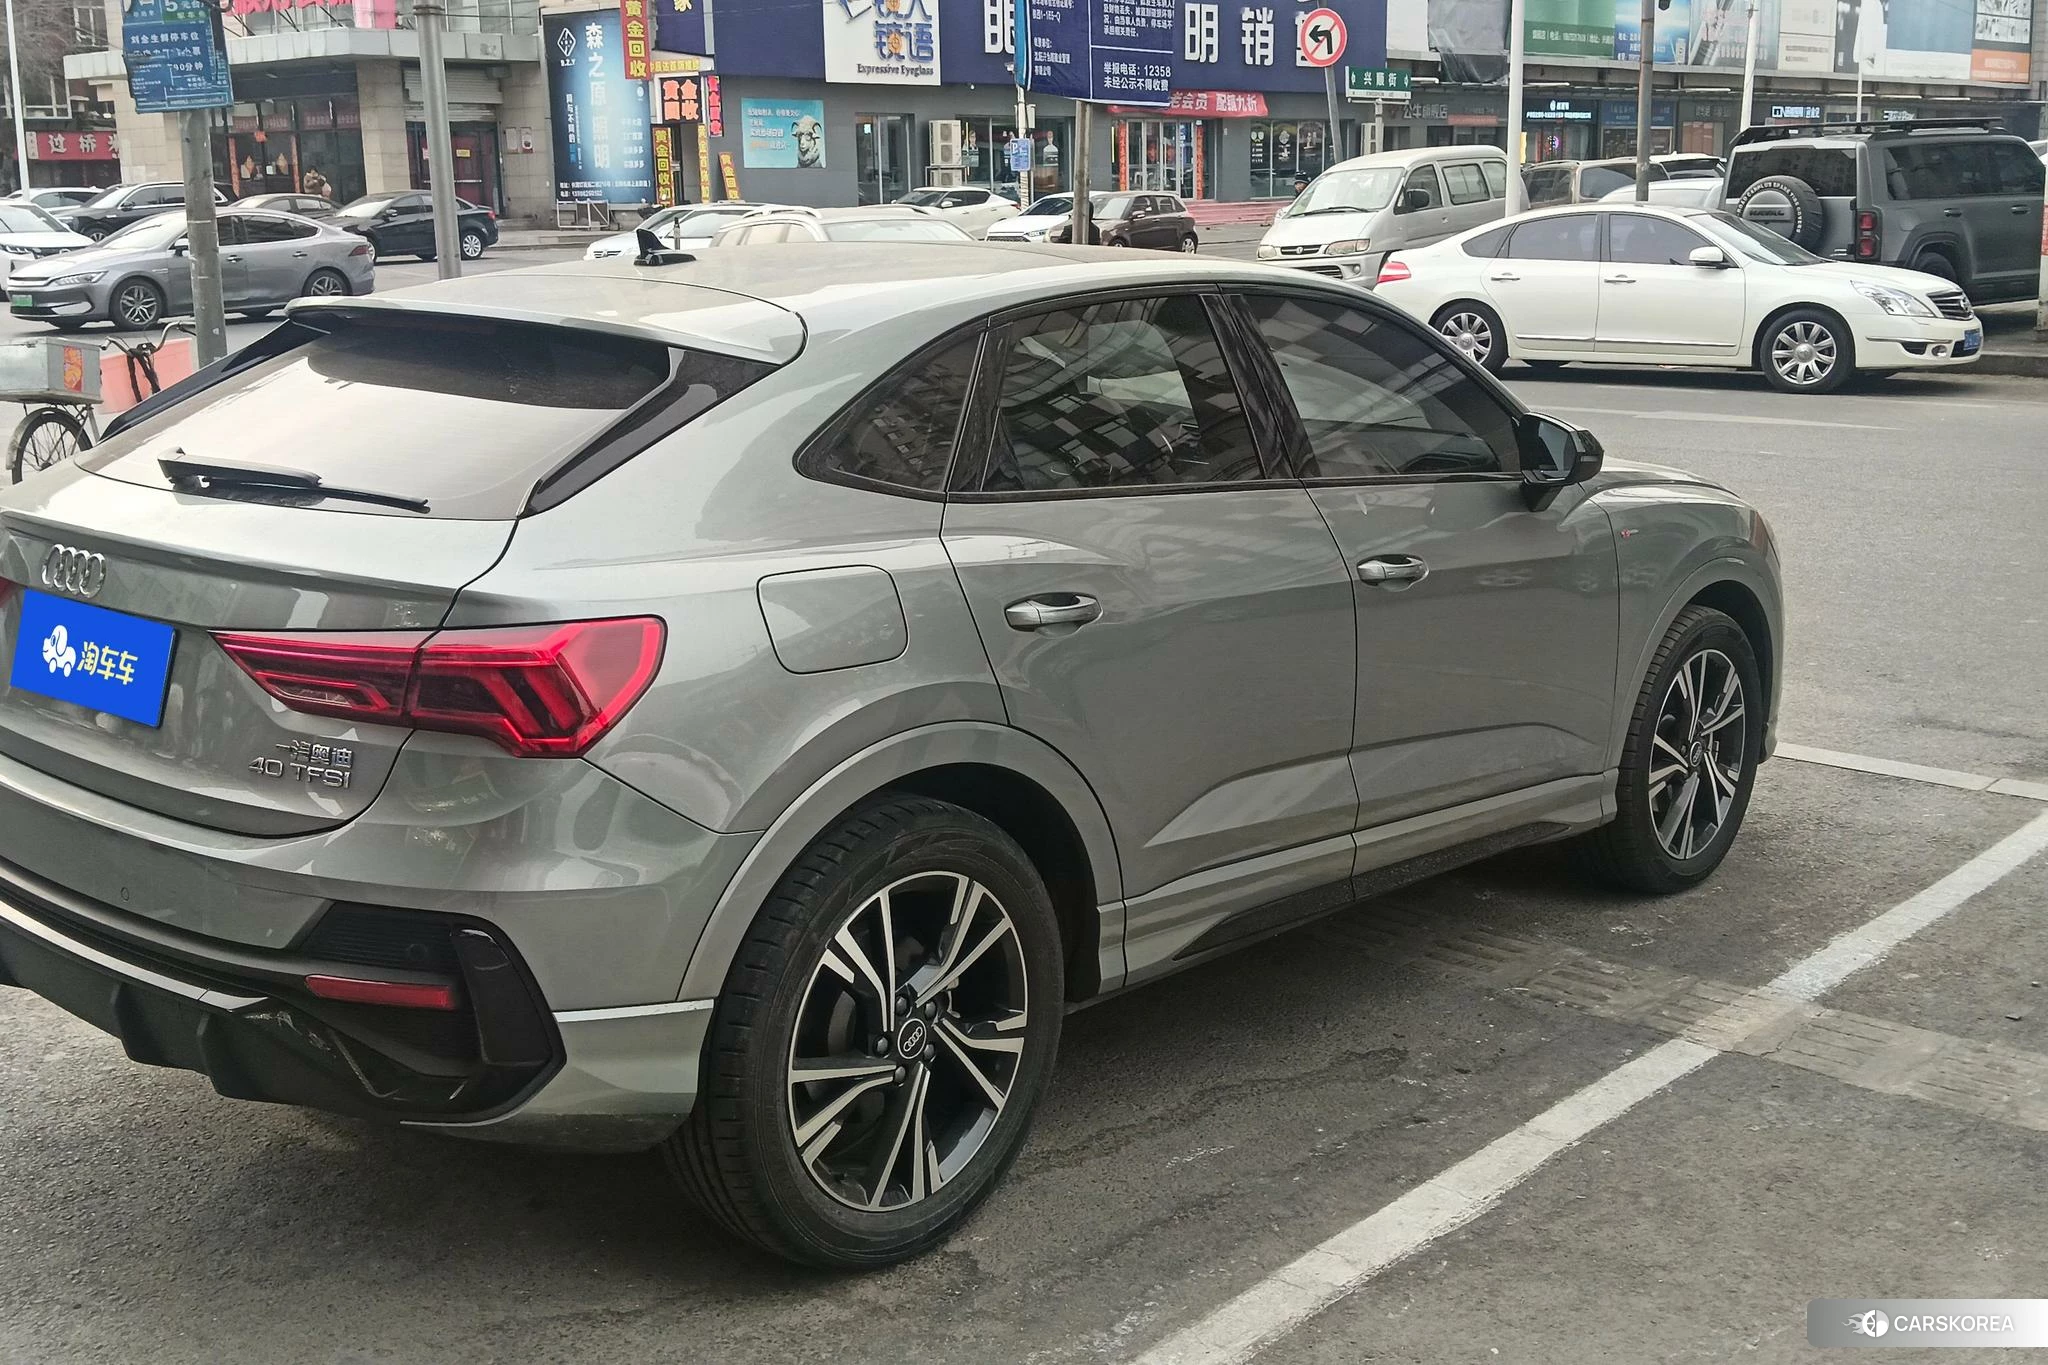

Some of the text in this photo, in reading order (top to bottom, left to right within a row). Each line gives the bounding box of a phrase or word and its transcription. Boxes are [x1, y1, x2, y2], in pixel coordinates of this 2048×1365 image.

[625, 0, 647, 77] 黄金回收
[857, 64, 934, 77] Expressive Eyeglass
[1103, 62, 1171, 78] 举报电话：12358
[1103, 77, 1169, 92] 未经公示不得收费
[1363, 71, 1397, 87] 兴顺街
[275, 739, 353, 768] 一汽奥迪
[248, 756, 350, 788] 40 TFSI
